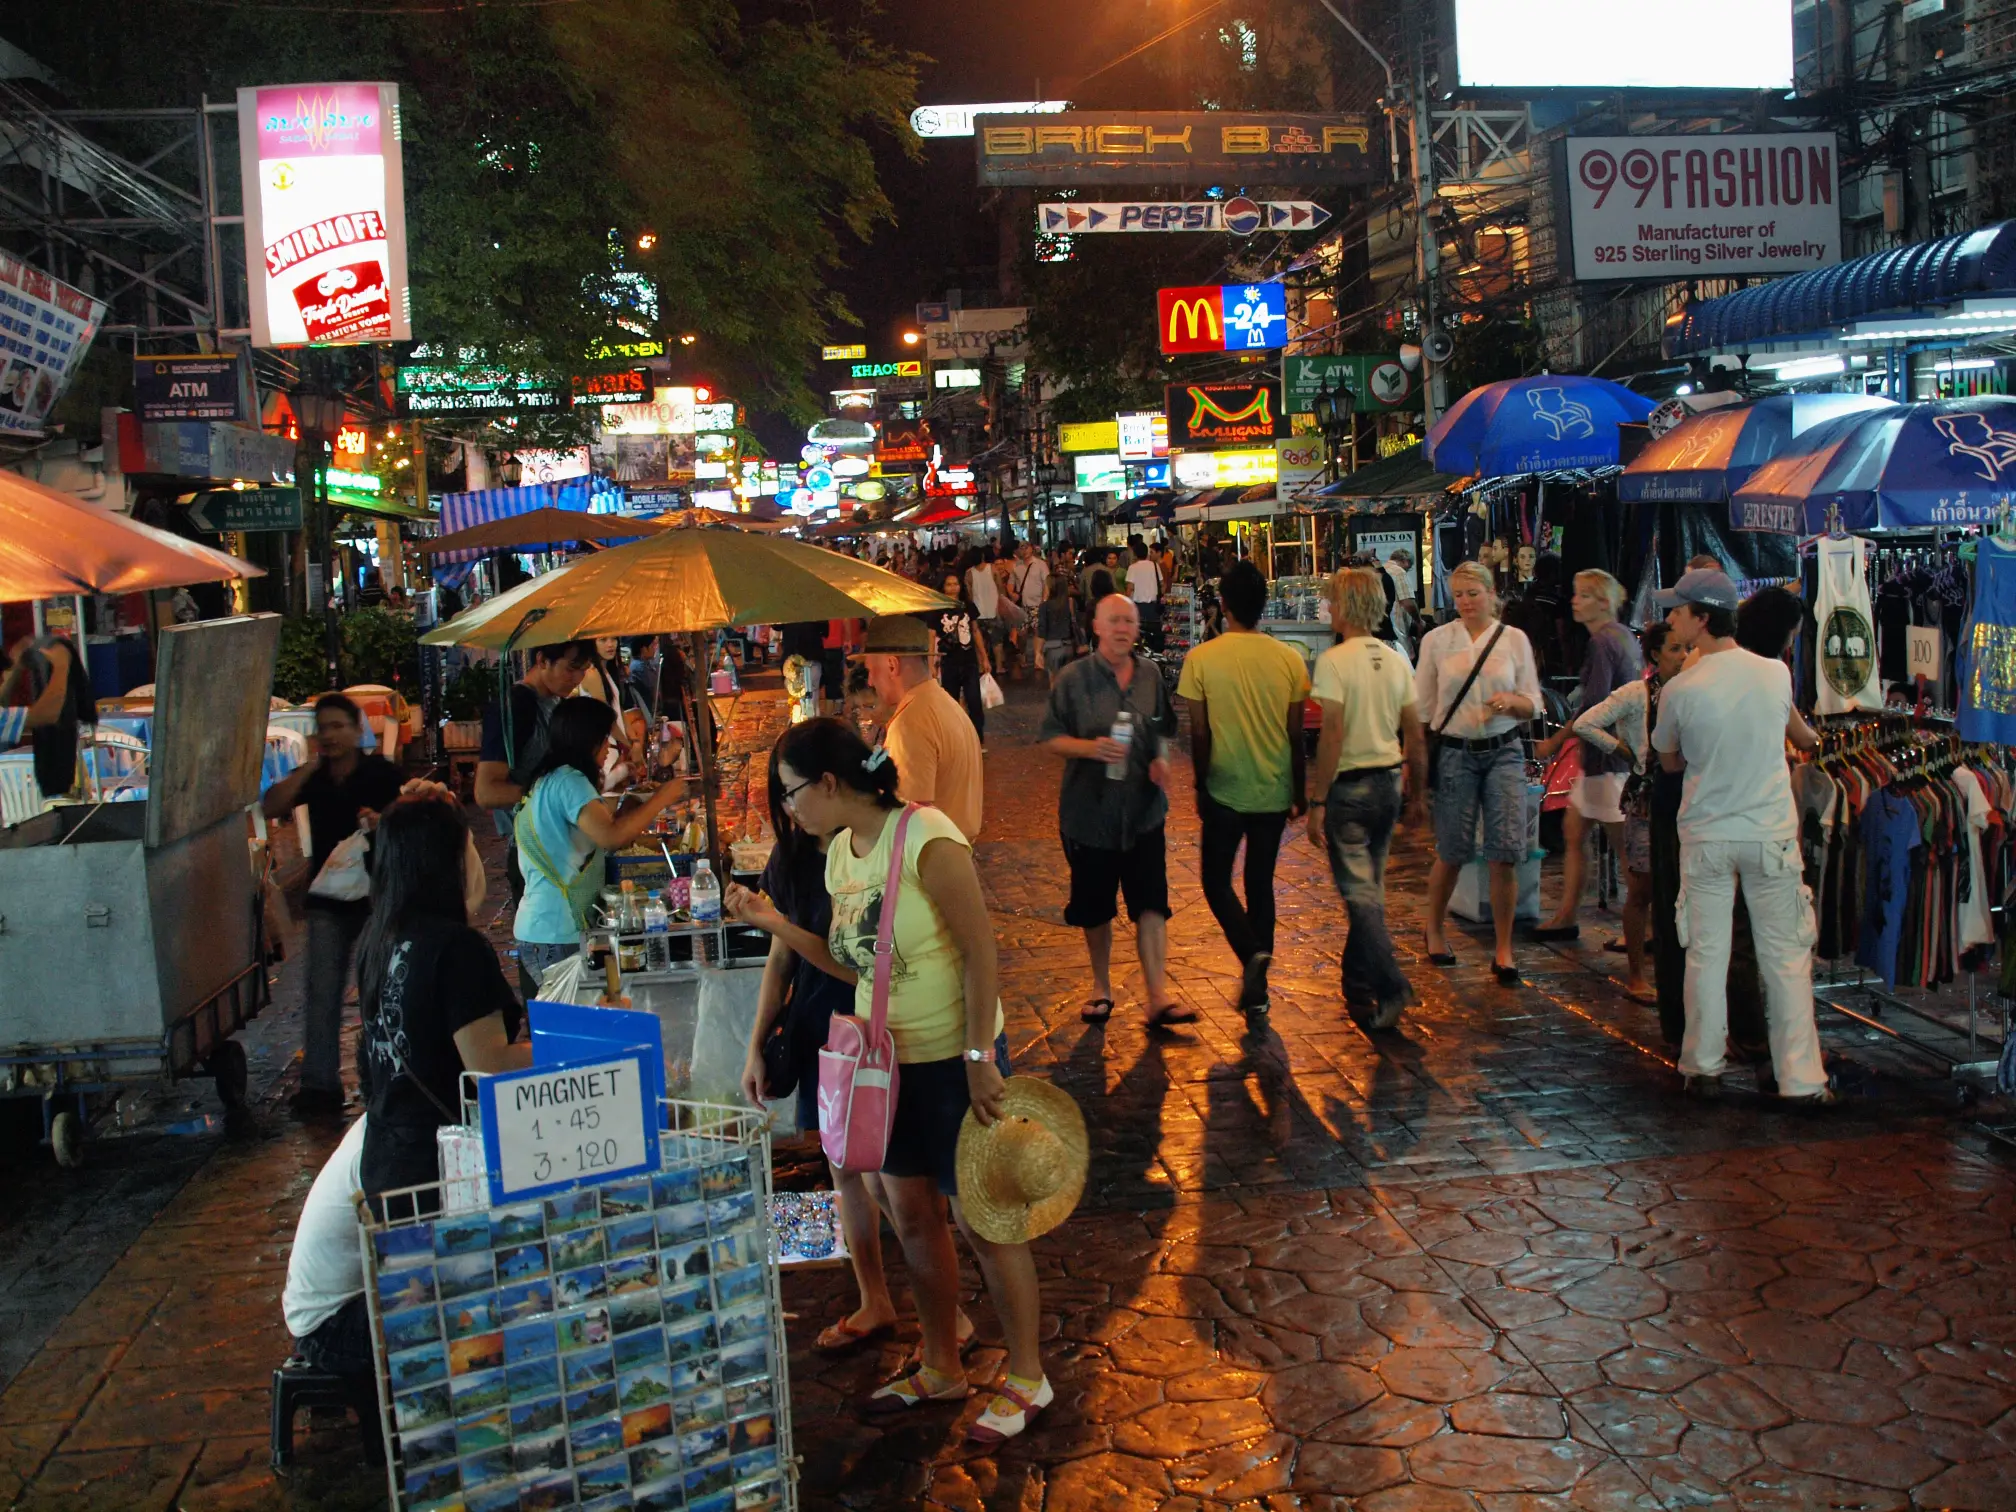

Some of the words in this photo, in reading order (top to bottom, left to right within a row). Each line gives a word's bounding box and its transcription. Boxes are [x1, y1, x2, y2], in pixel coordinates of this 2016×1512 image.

[1119, 206, 1214, 230] PEPSI
[1638, 224, 1755, 241] Manufacturer
[1758, 221, 1776, 238] of
[1594, 246, 1627, 262] 925
[1632, 244, 1701, 264] Sterling
[1704, 243, 1755, 260] Silver
[1757, 240, 1826, 260] Jewelry
[358, 313, 392, 329] VODKA
[1233, 302, 1270, 330] 24
[1325, 365, 1354, 377] ATM
[169, 382, 209, 398] ATM
[632, 496, 656, 504] MOBILE
[657, 494, 679, 503] PHONE
[1360, 533, 1396, 543] WHATS
[1398, 532, 1413, 540] ON
[1913, 639, 1932, 664] 100
[516, 1069, 621, 1111] MAGNET
[531, 1119, 543, 1140] 1
[570, 1105, 601, 1131] 45
[533, 1152, 552, 1182] 3
[576, 1138, 617, 1171] 120
